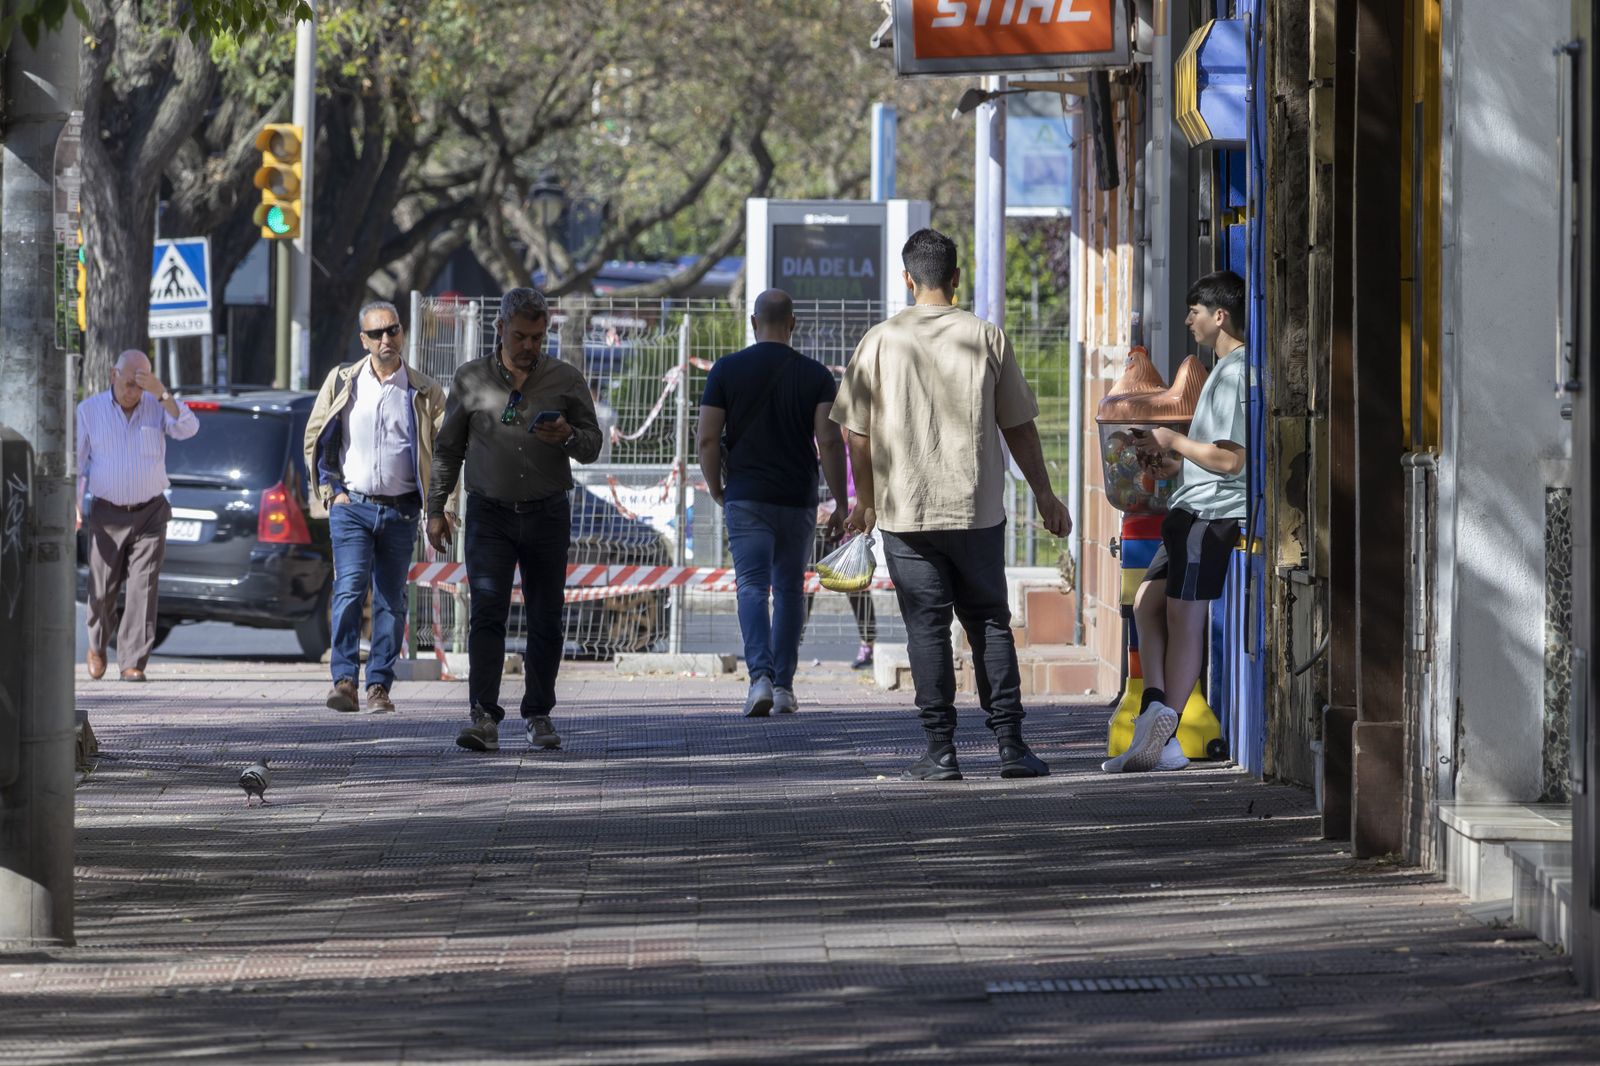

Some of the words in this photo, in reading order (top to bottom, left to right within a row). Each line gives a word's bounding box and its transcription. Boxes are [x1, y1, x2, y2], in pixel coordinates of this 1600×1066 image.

[783, 257, 816, 276] DIA
[819, 257, 845, 276] DE
[848, 257, 875, 277] LA
